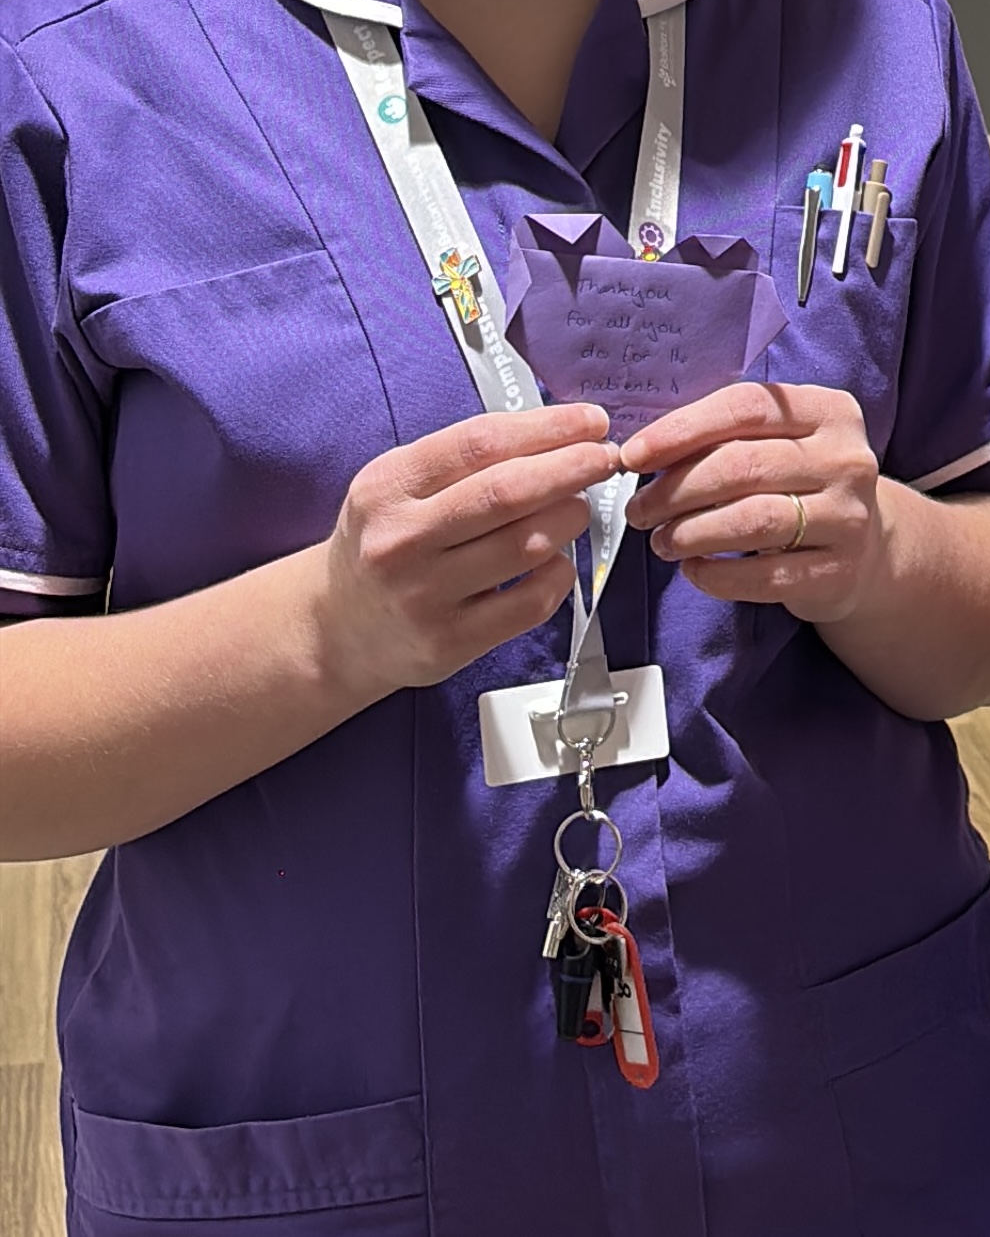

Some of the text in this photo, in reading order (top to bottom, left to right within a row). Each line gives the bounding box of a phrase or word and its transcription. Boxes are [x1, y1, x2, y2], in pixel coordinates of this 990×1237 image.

[353, 24, 395, 97] Respect
[646, 121, 672, 221] Inclusivity
[580, 343, 609, 359] do
[606, 316, 631, 329] all
[641, 321, 682, 342] you
